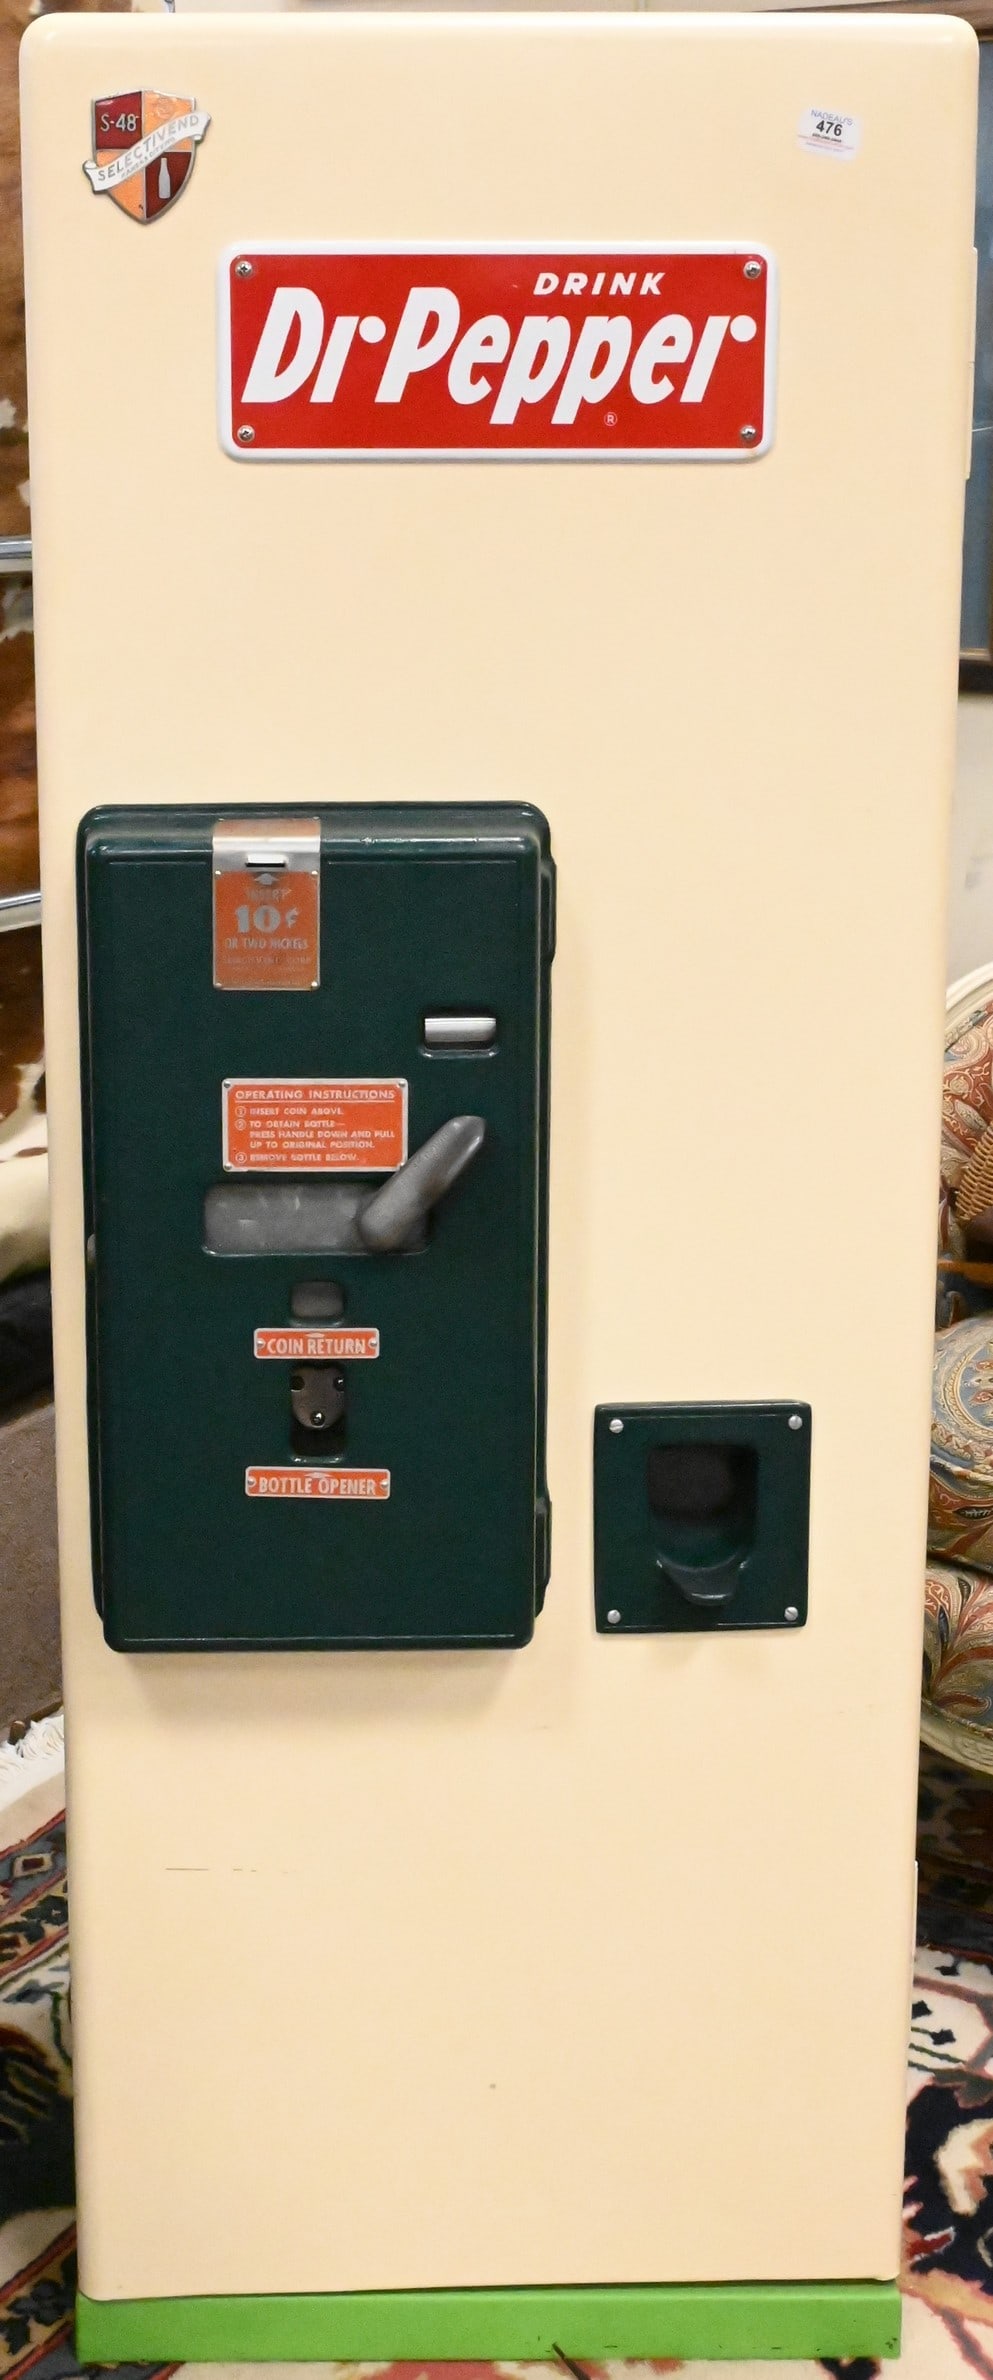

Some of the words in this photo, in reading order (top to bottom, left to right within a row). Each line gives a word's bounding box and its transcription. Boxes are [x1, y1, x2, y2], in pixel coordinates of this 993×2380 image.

[816, 120, 843, 136] 476
[98, 115, 199, 181] SELECTIVEND
[533, 272, 666, 295] DRINK
[235, 904, 299, 934] 10¢
[235, 1089, 303, 1100] OPERATING
[309, 1090, 395, 1100] INSTRUCTIONS
[250, 1107, 279, 1115] INSERT
[284, 1107, 307, 1115] COIN
[250, 1120, 262, 1128] TO
[268, 1120, 300, 1128] OBTAIN
[278, 1130, 314, 1138] HANDLE
[318, 1130, 347, 1138] DOWN
[351, 1130, 371, 1138] AND
[374, 1130, 394, 1138] PULL
[250, 1141, 262, 1149] UP
[266, 1141, 278, 1149] TO
[282, 1141, 326, 1149] ORIGINAL
[250, 1153, 287, 1162] REMOVE
[291, 1153, 321, 1161] BOTTLE
[267, 1338, 303, 1354] COIN
[307, 1338, 365, 1354] RETURN
[258, 1477, 312, 1494] BOTTLE
[318, 1479, 376, 1495] OPENER
